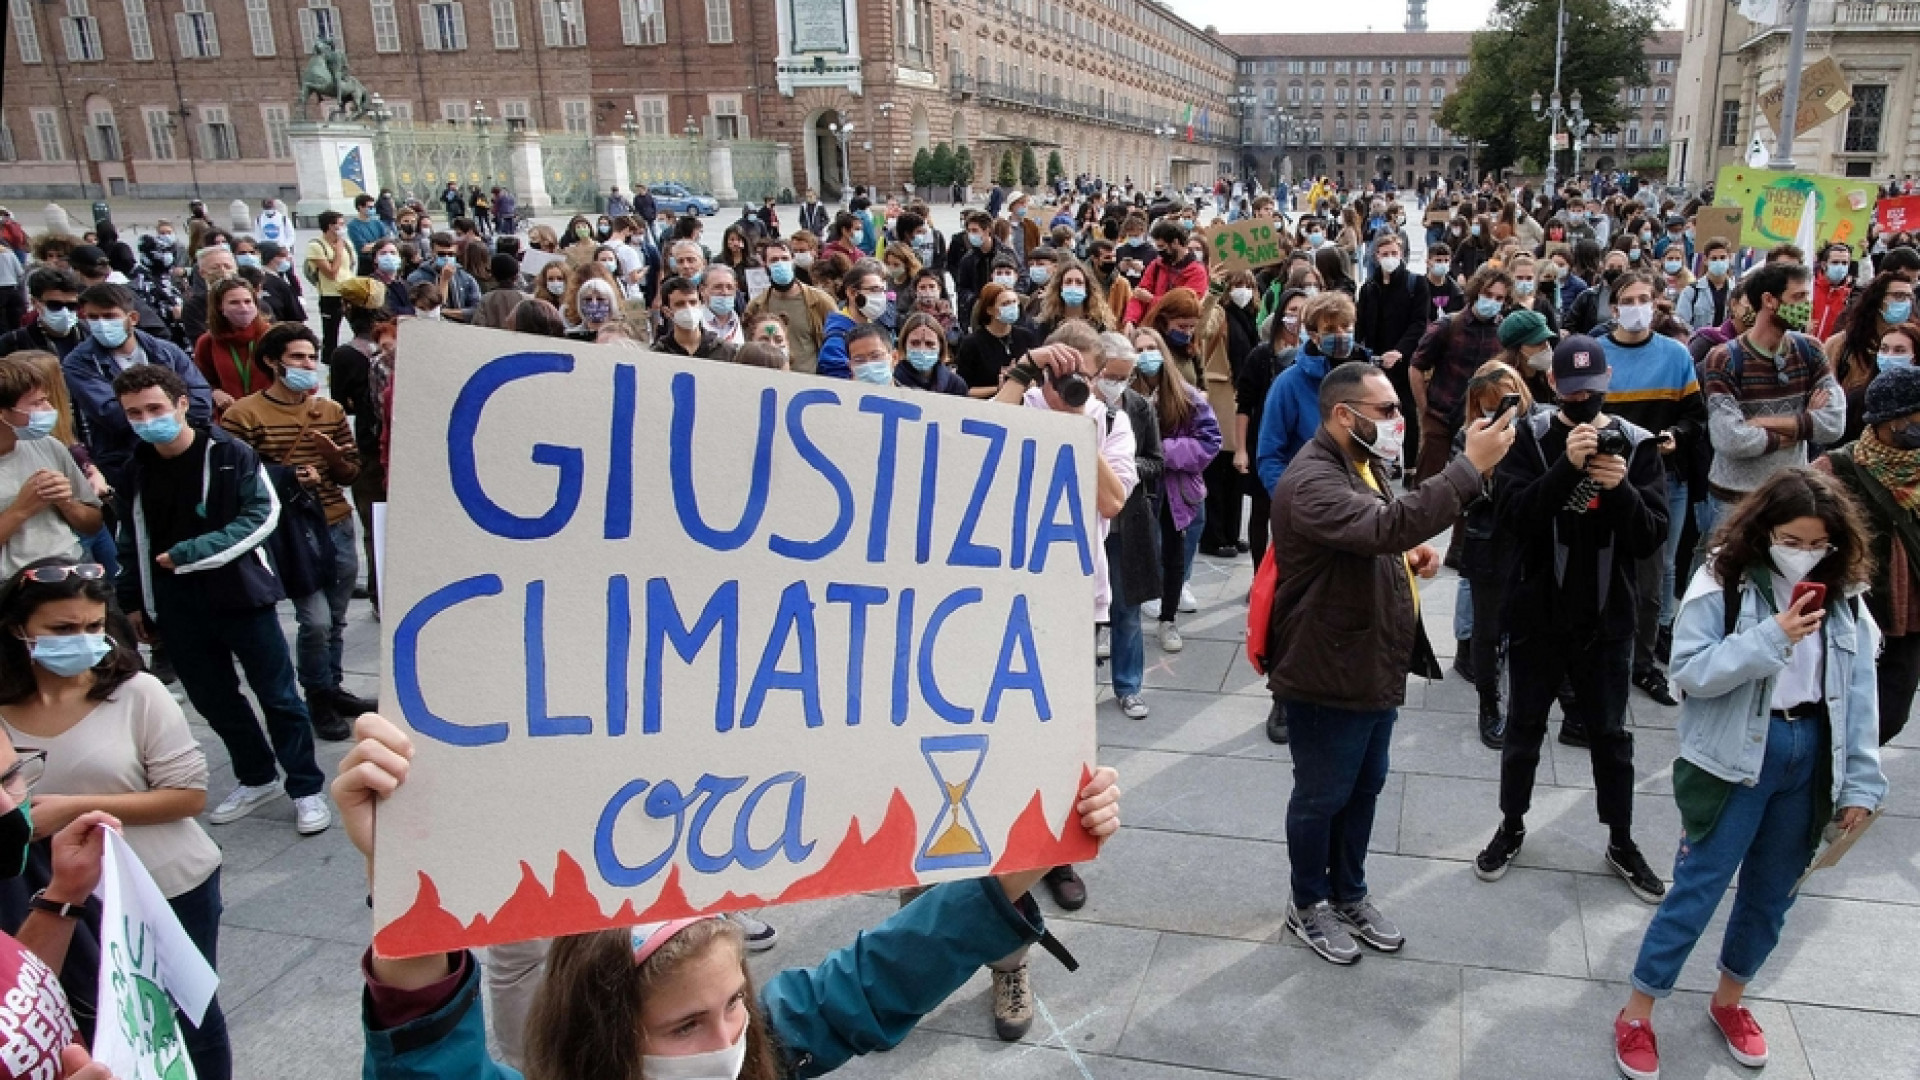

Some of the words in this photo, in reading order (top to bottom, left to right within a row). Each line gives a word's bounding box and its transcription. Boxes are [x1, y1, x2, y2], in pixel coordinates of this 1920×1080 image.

[1250, 226, 1271, 241] TO
[1773, 206, 1799, 218] NOT
[448, 352, 1094, 575] GIUSTIZIA
[393, 574, 1052, 746] CLIMATICA
[594, 772, 818, 887] ora
